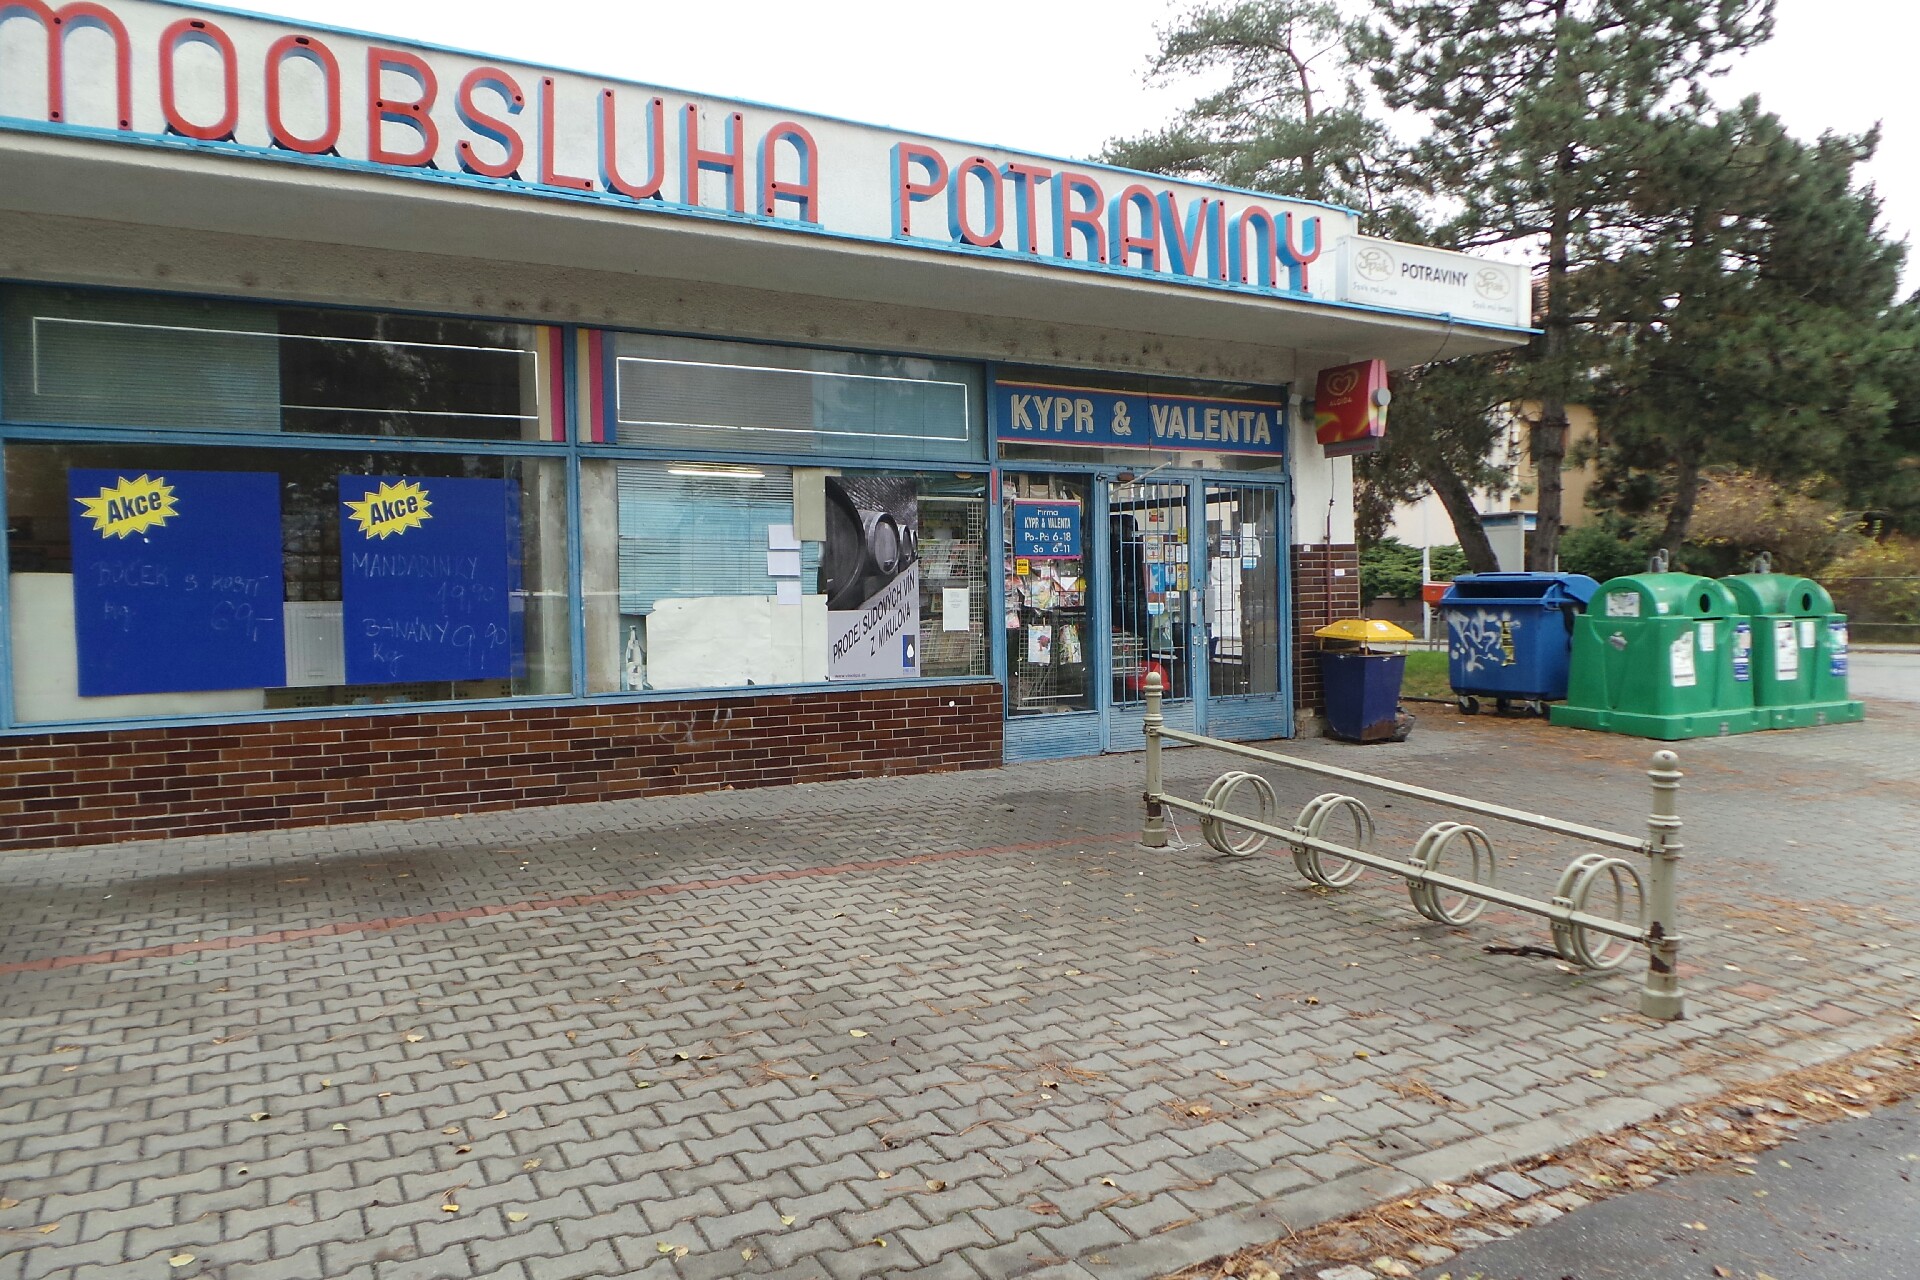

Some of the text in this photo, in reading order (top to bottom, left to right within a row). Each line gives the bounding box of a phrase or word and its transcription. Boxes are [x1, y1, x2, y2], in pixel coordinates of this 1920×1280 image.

[892, 141, 1321, 293] POTRAVINY
[1401, 262, 1469, 287] POTRAVINY
[1010, 394, 1271, 445] KYPR & VALENTA
[107, 491, 162, 524] Akce
[370, 495, 419, 526] Akce
[1024, 517, 1039, 528] KYPR
[1048, 517, 1070, 528] VALENTA
[352, 552, 478, 580] MANDARINKY
[833, 569, 915, 664] PRODEJ SUDOVÝCH VÍN
[870, 601, 911, 657] Z MIKULOVA
